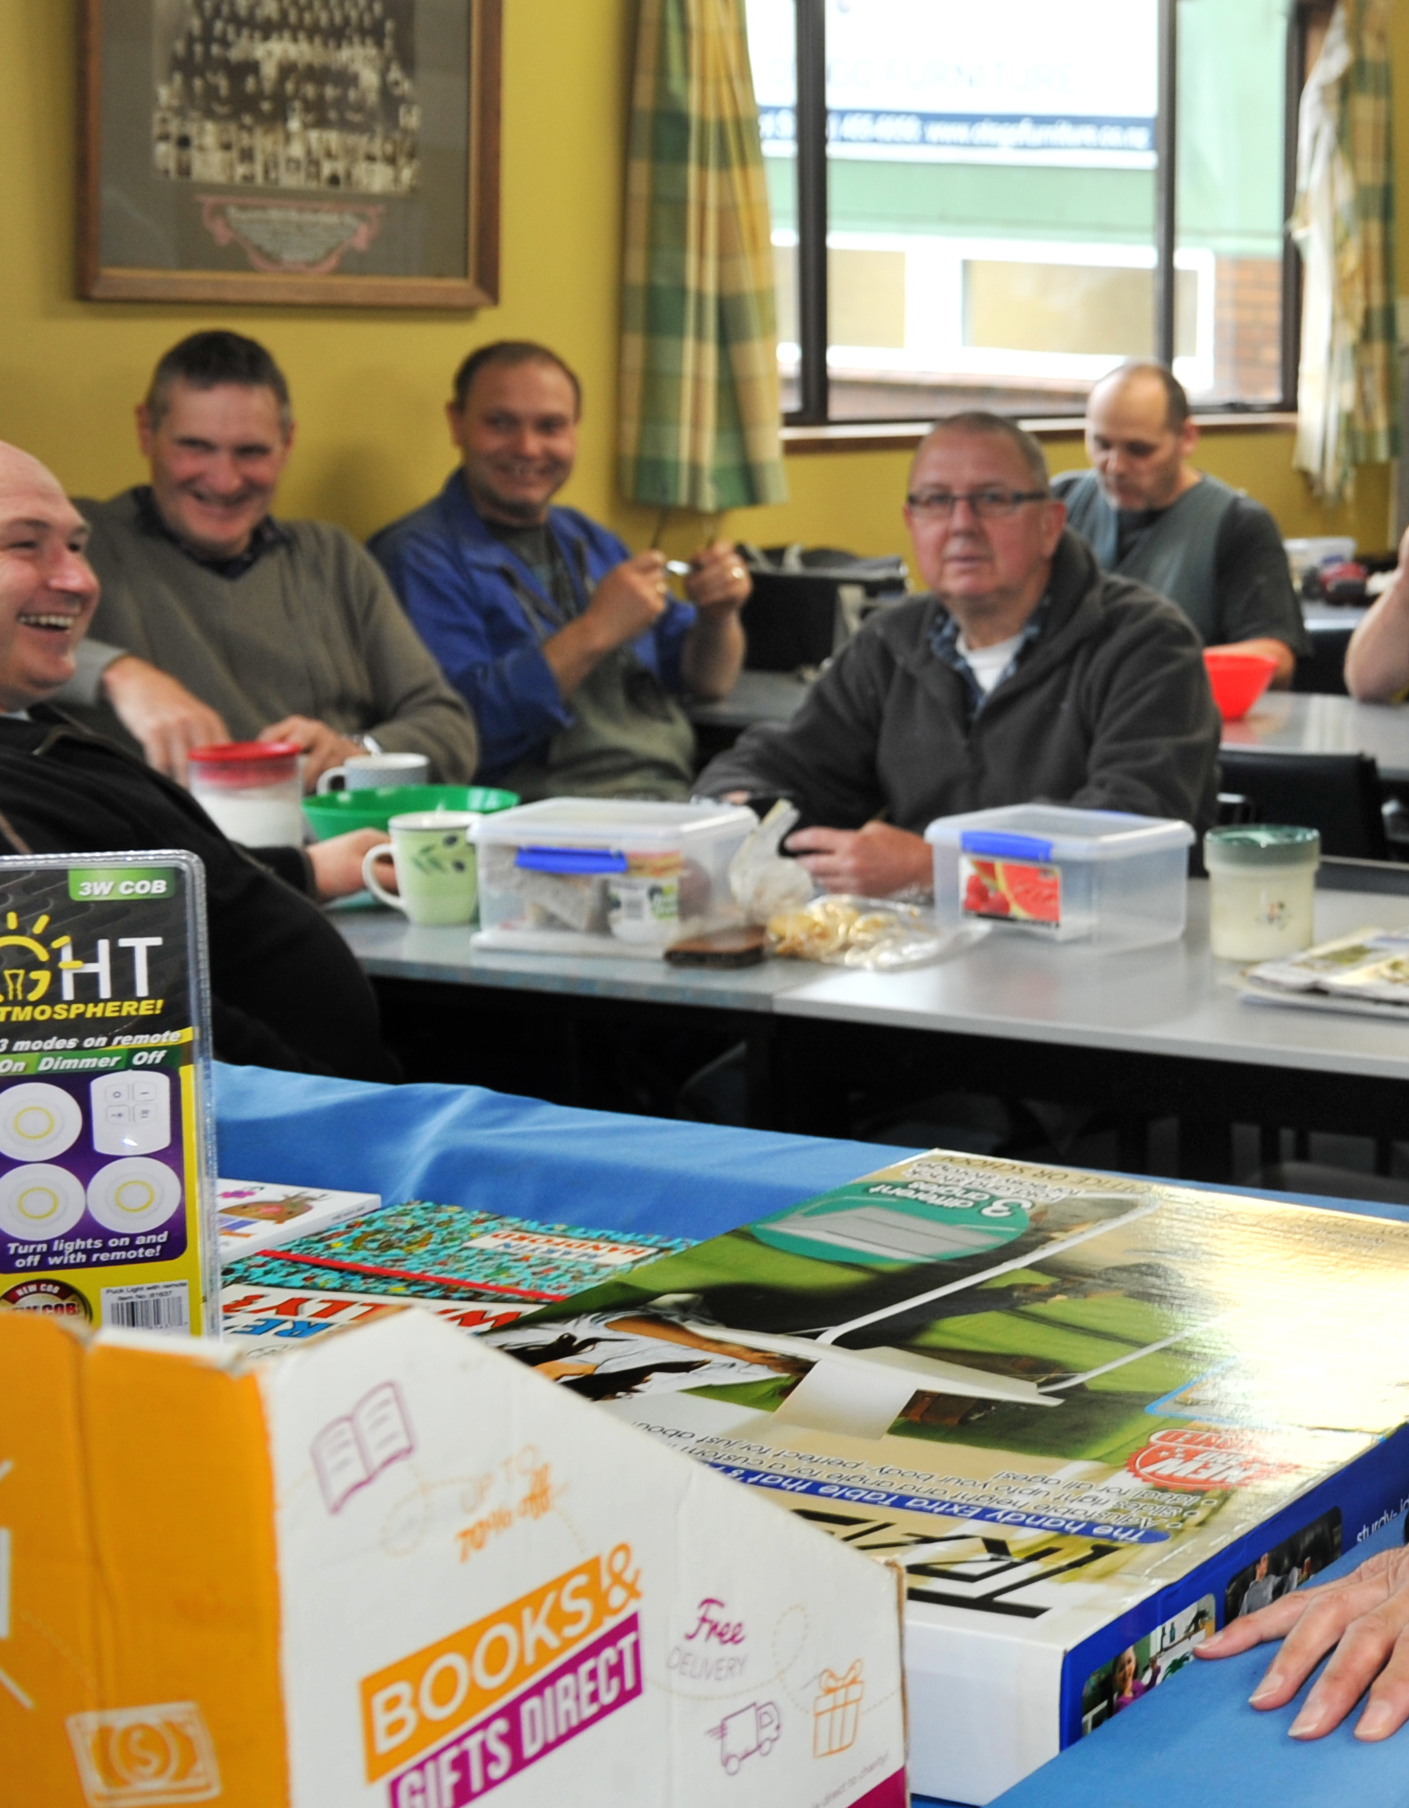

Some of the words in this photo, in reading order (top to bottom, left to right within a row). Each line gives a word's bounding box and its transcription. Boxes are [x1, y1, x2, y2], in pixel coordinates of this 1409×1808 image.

[78, 881, 114, 896] 3W
[118, 879, 168, 895] COB
[12, 1035, 79, 1052] modes
[83, 1034, 108, 1049] on
[112, 1030, 182, 1047] remote
[0, 1058, 27, 1074] On
[37, 1053, 122, 1072] Dimmer
[131, 1049, 168, 1066] Off
[868, 1183, 975, 1210] different
[908, 1181, 991, 1201] angles
[980, 1199, 1034, 1218] 3
[6, 1242, 48, 1256] Turn
[52, 1236, 104, 1256] lights
[108, 1236, 131, 1248] on
[135, 1230, 169, 1246] and
[493, 1232, 645, 1257] HANDFORD
[14, 1253, 42, 1269] off
[47, 1250, 87, 1266] with
[91, 1245, 163, 1263] remote!
[15, 1283, 38, 1298] NEW
[105, 1287, 125, 1296] Puck
[126, 1285, 145, 1296] Light
[161, 1281, 189, 1291] remote
[222, 1294, 522, 1328] WLLY?
[696, 1434, 739, 1451] just
[737, 1440, 773, 1457] for
[680, 1445, 764, 1469] custom
[768, 1462, 787, 1472] a
[772, 1447, 864, 1471] perfect
[730, 1466, 813, 1494] that's
[789, 1465, 823, 1479] for
[826, 1469, 896, 1490] angle
[992, 1469, 1061, 1487] ages!
[1139, 1457, 1261, 1484] NEW
[898, 1481, 949, 1500] and
[938, 1473, 991, 1492] your
[993, 1482, 1052, 1501] upto
[1060, 1479, 1094, 1495] all
[1096, 1483, 1131, 1498] for
[818, 1484, 900, 1507] Table
[951, 1489, 1027, 1513] height
[1052, 1487, 1107, 1508] right
[1131, 1486, 1201, 1507] Ideal
[905, 1496, 979, 1519] Extra
[1032, 1501, 1159, 1530] Adjustable
[1108, 1496, 1183, 1517] Slides
[985, 1507, 1087, 1538] handy
[1091, 1525, 1145, 1543] The
[683, 1597, 746, 1646] Free
[370, 1573, 595, 1758] BOOKS
[600, 1543, 642, 1620] &
[665, 1645, 749, 1682] DELIVERY
[395, 1716, 514, 1808] GIFTS
[519, 1631, 639, 1761] DIRECT
